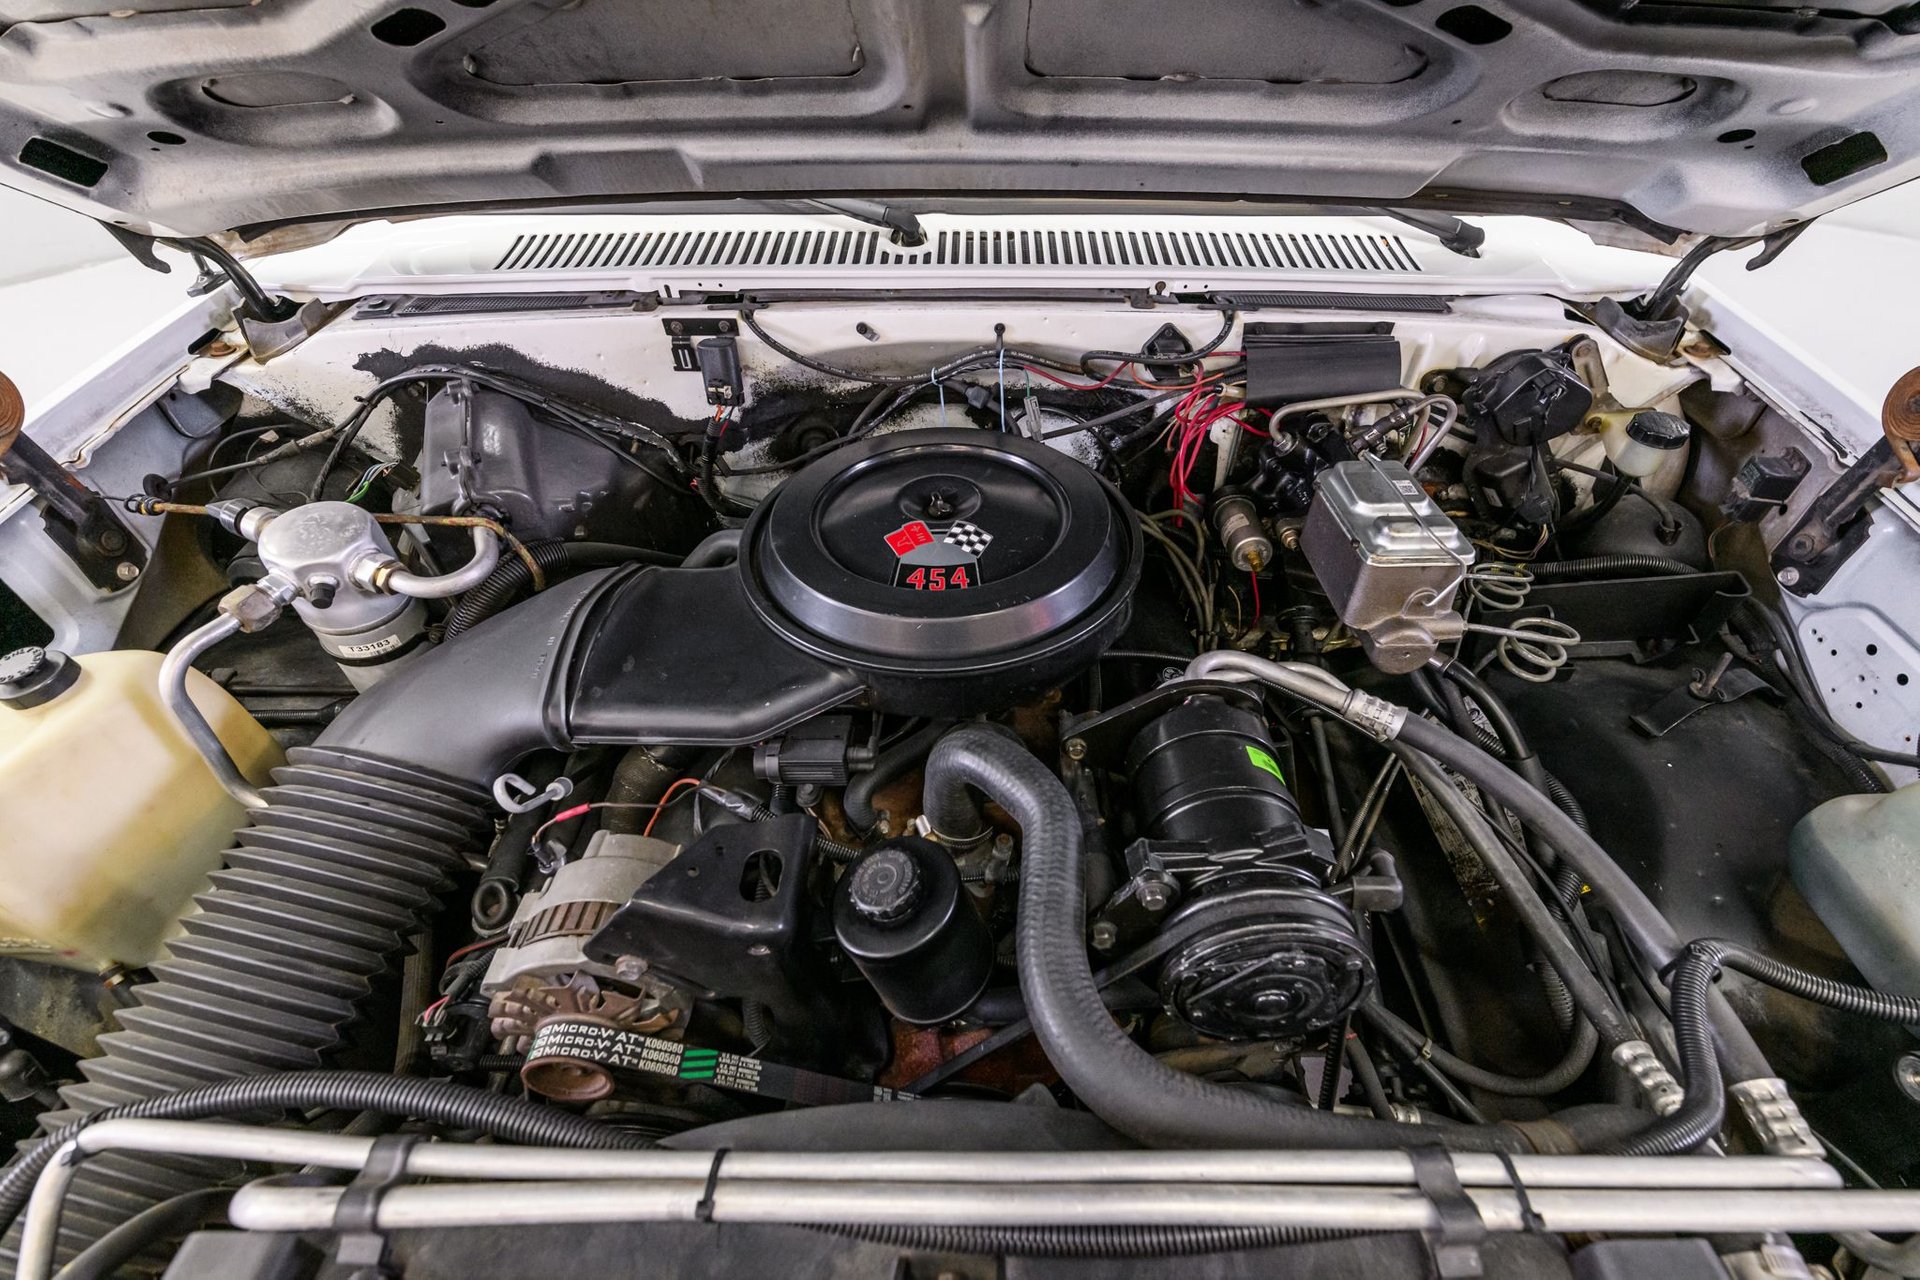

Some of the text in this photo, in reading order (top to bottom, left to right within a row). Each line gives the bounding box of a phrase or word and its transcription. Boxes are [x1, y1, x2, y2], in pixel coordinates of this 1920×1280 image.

[906, 566, 970, 592] 454
[348, 639, 391, 653] T33183
[644, 1036, 684, 1054] K060560
[641, 1047, 681, 1066] K060560
[638, 1059, 679, 1077] K060560
